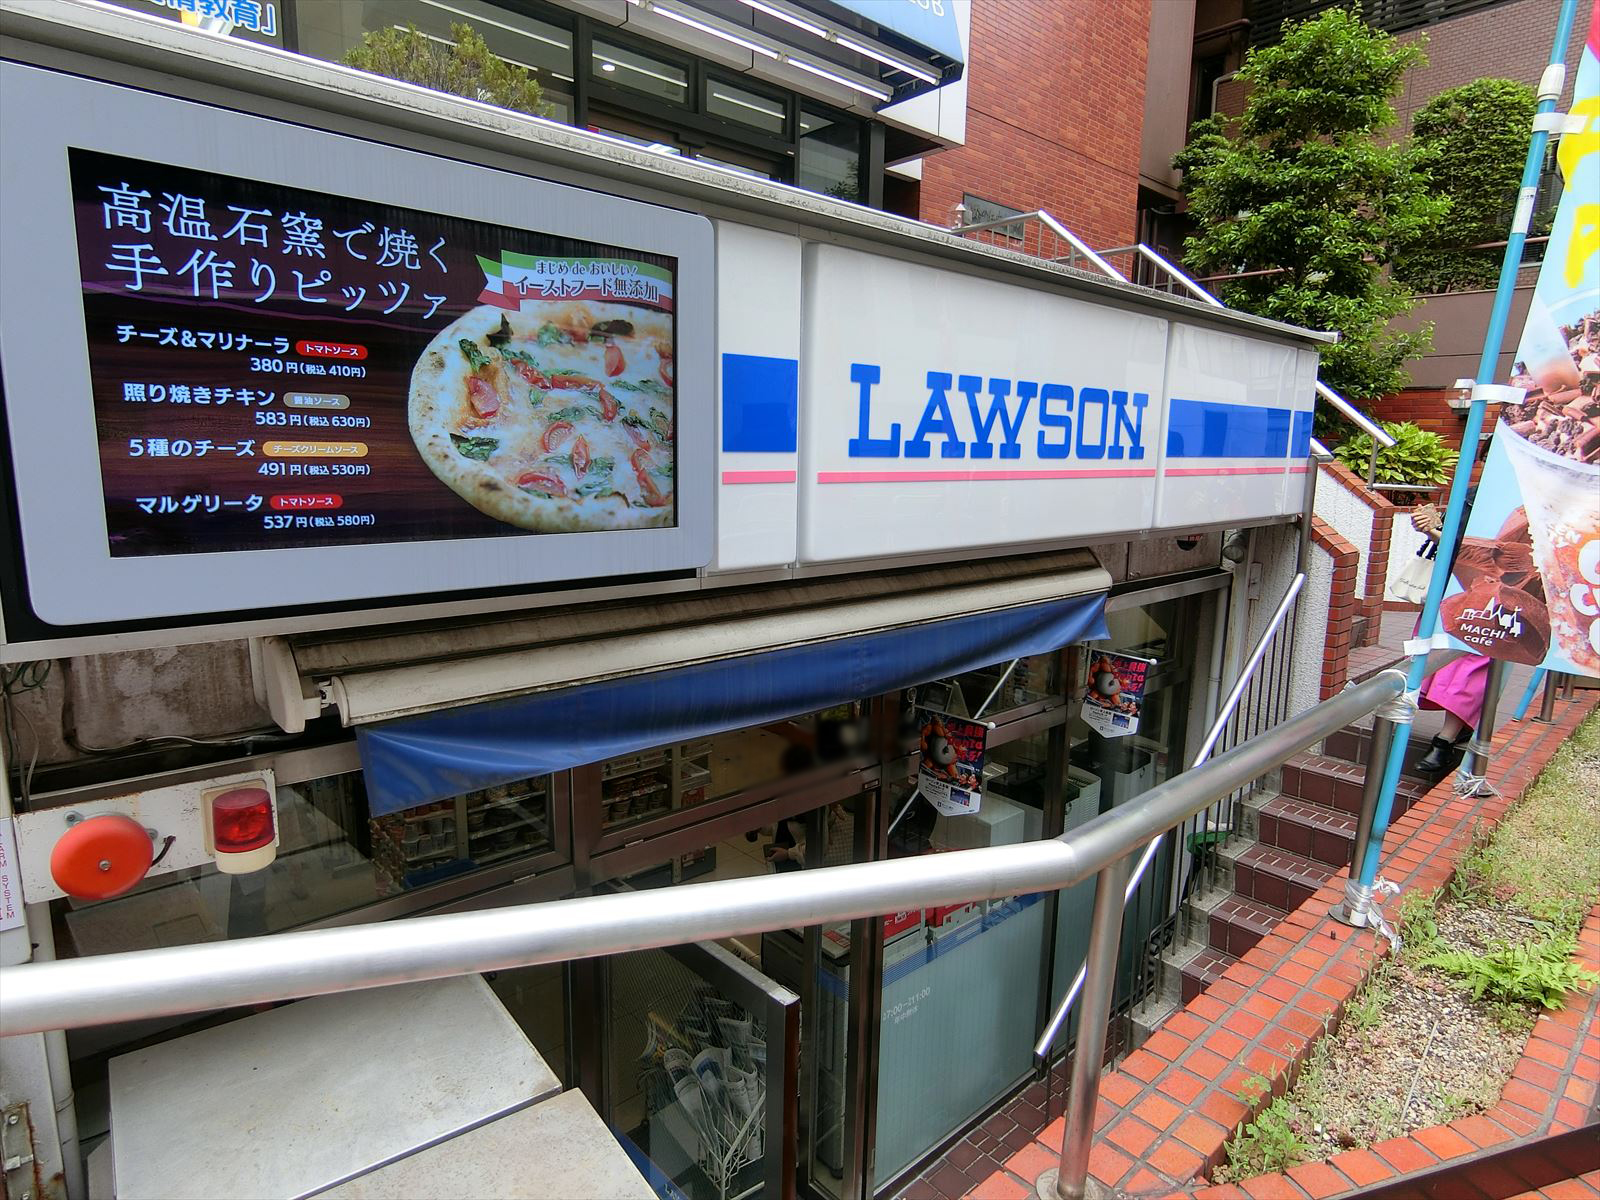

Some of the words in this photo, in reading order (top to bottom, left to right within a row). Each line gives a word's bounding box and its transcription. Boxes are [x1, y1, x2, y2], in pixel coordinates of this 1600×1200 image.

[97, 182, 448, 274] 高温石窯で焼く
[105, 244, 447, 319] 手作りピッツァ
[514, 276, 659, 301] イーストフード無添加
[116, 324, 290, 355] チーズ&マリナーラ
[305, 344, 359, 357] トマトソース
[122, 382, 276, 407] 照り焼きチキン
[848, 363, 1149, 460] LAWSON
[128, 438, 256, 458] 5種のチーズ
[273, 444, 359, 455] チーズクリームソース
[136, 494, 263, 514] マルゲリータ
[280, 496, 333, 506] トマトソース
[1460, 623, 1506, 639] MACHI
[1463, 635, 1493, 646] café
[2, 874, 15, 919] SYSTEM
